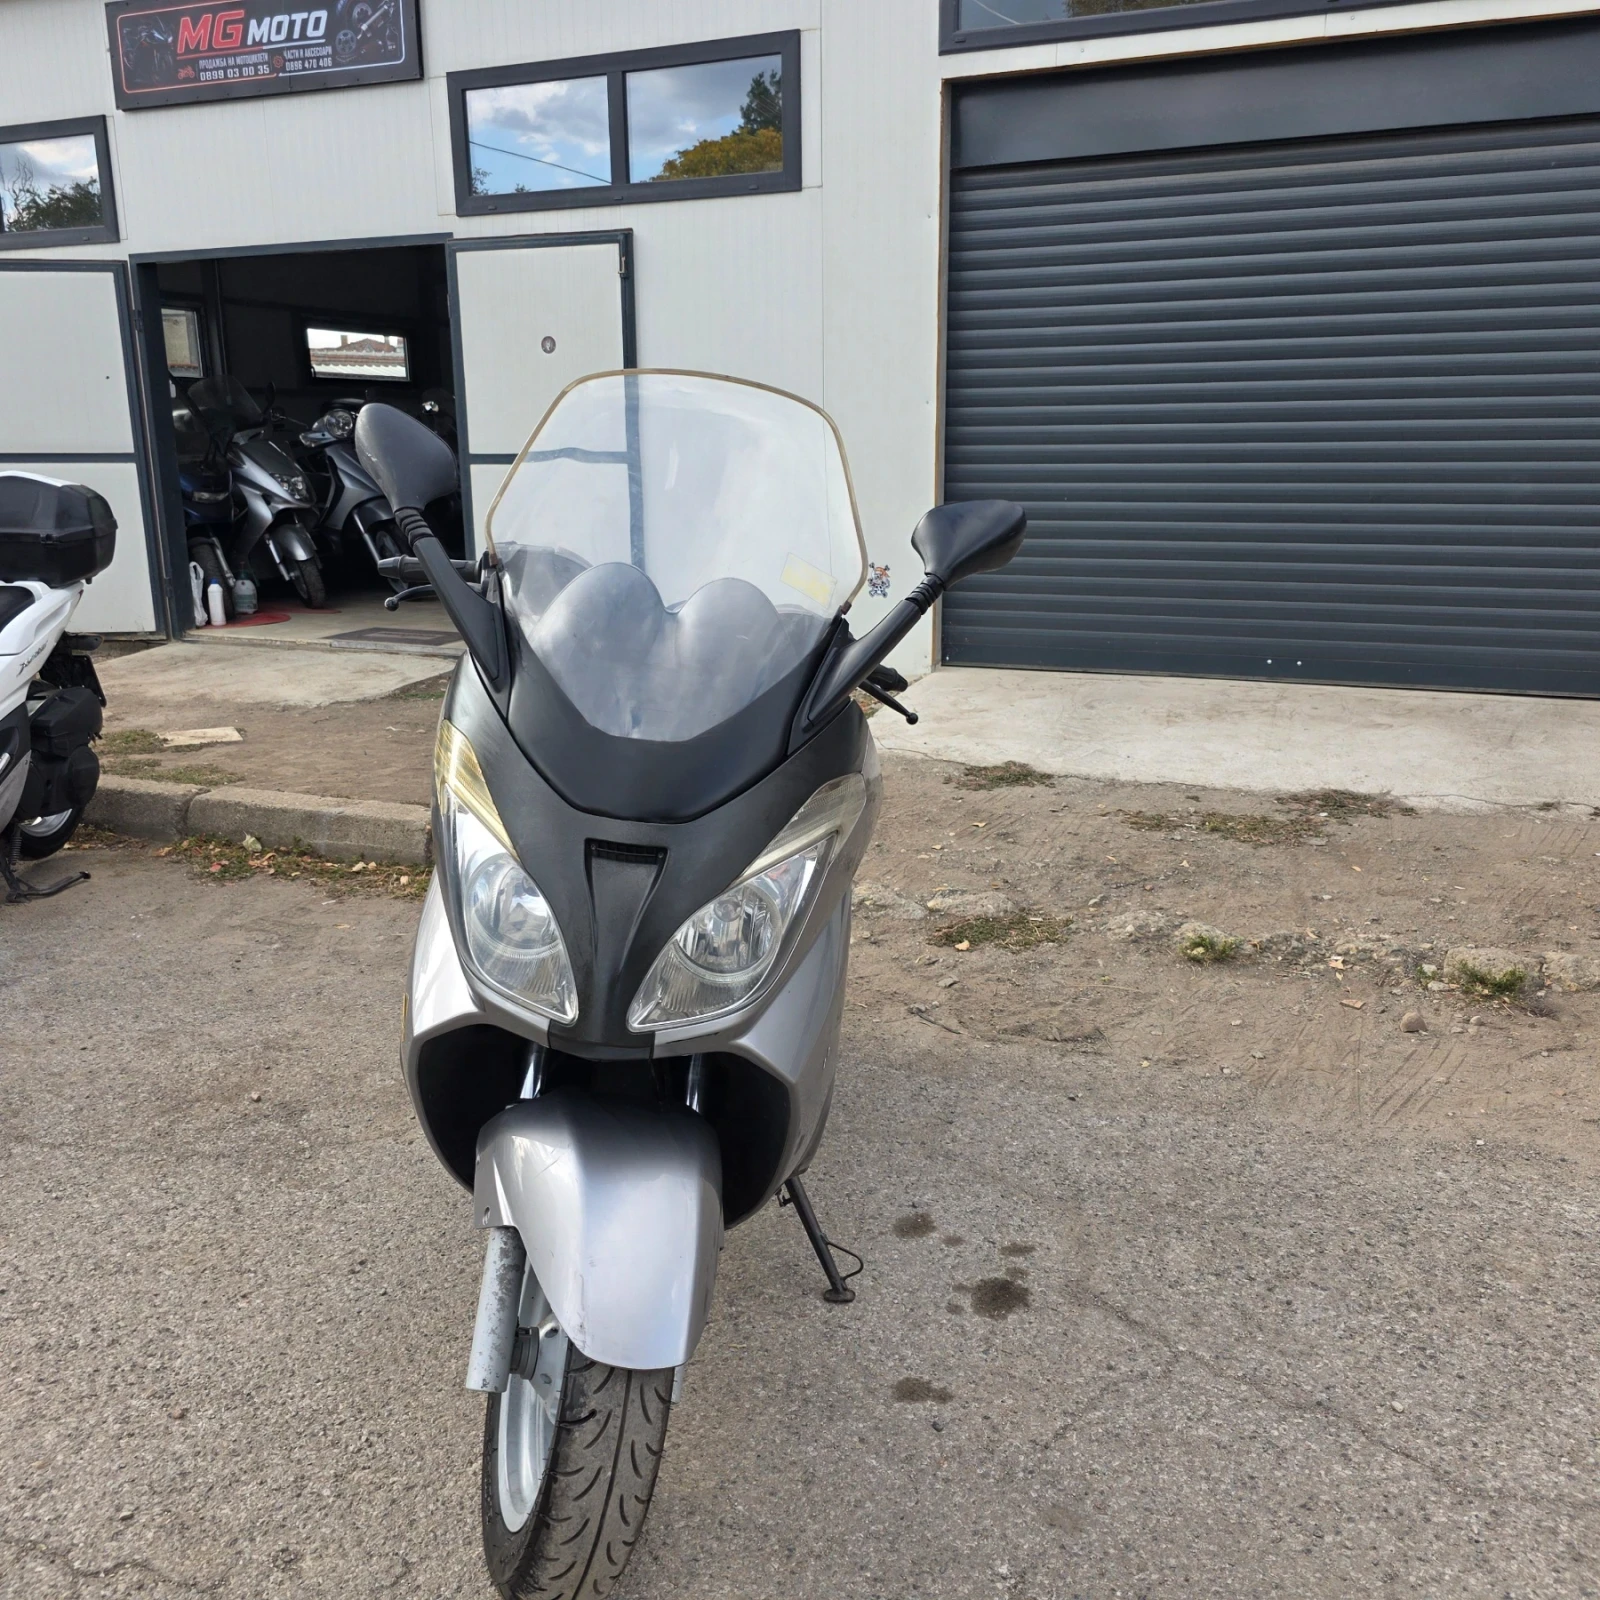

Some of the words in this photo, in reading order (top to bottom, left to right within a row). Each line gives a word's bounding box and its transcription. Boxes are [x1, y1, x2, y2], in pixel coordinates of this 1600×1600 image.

[177, 9, 245, 54] MG
[247, 9, 328, 46] MOTO
[200, 69, 225, 81] 0899
[227, 68, 240, 78] 03
[242, 66, 255, 77] 00
[257, 64, 270, 75] 35
